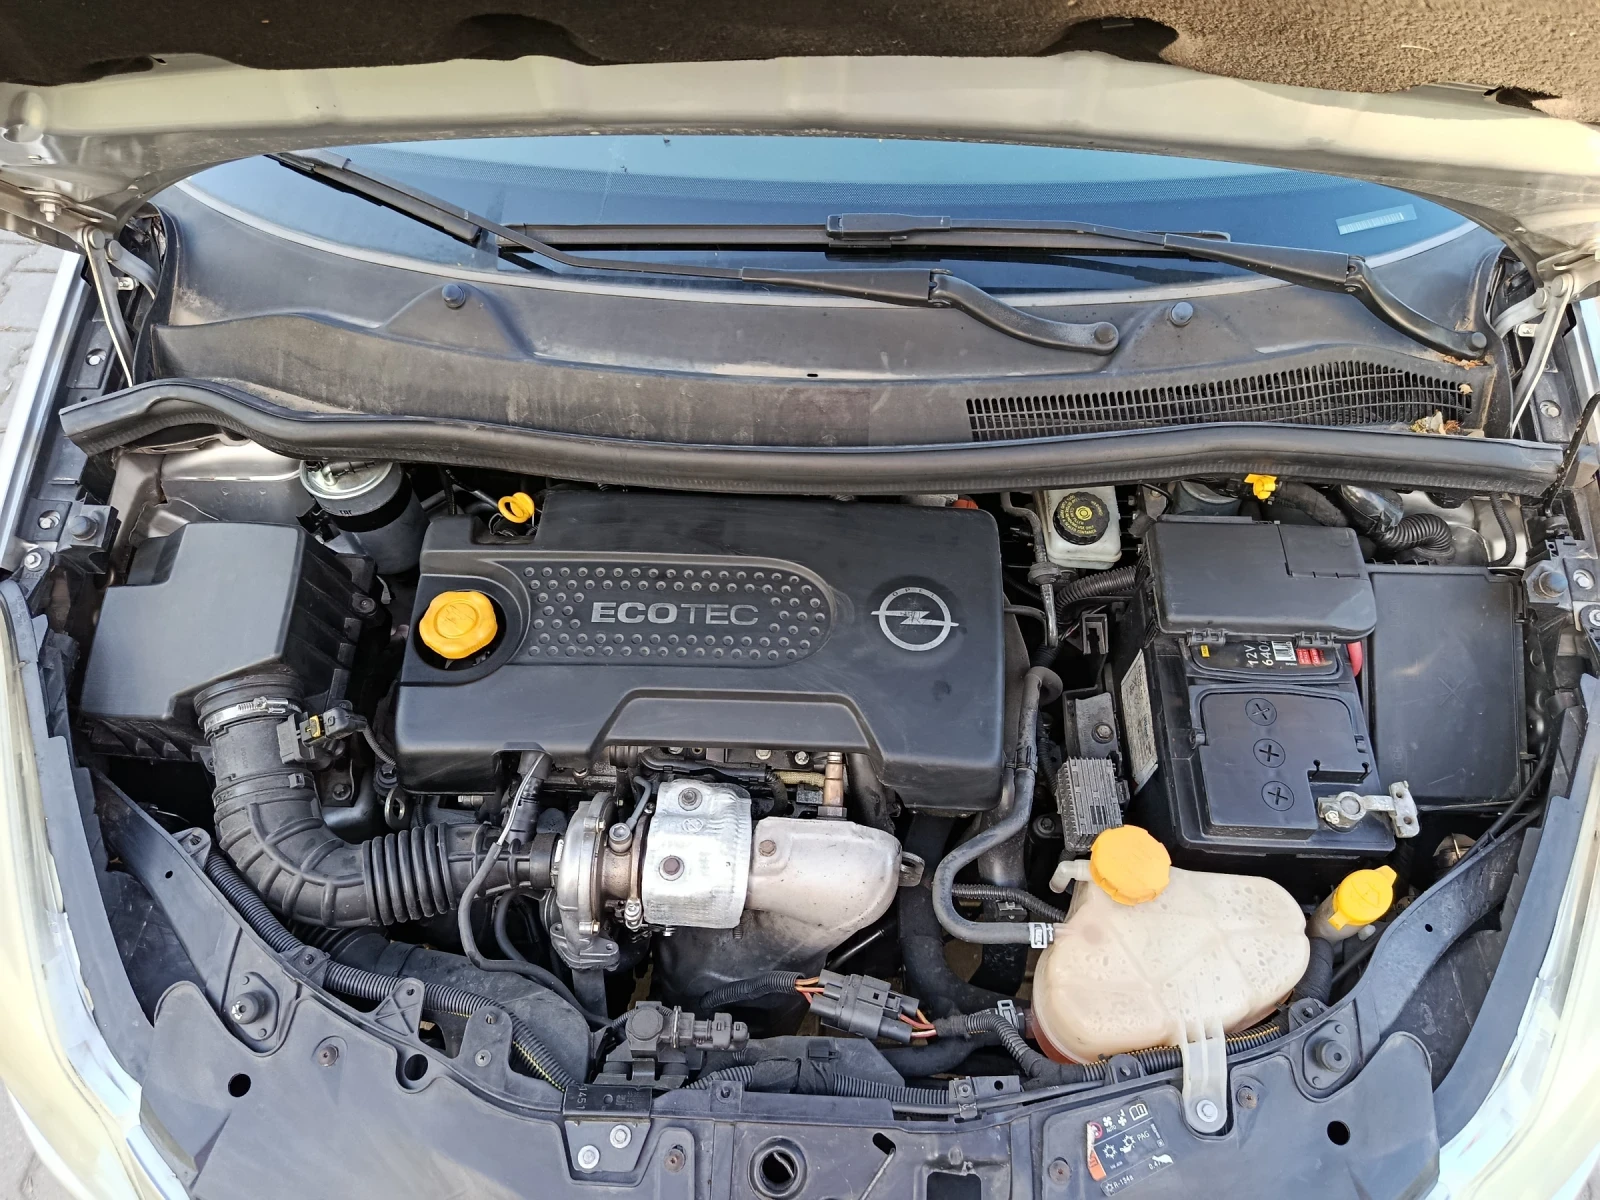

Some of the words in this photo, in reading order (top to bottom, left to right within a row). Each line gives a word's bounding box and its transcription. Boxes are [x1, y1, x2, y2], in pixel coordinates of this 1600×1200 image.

[892, 587, 935, 598] OPEL
[590, 601, 760, 626] ECOTEC
[1244, 645, 1259, 668] 12V
[1136, 1130, 1150, 1141] PAG
[1113, 1174, 1135, 1189] R-134a
